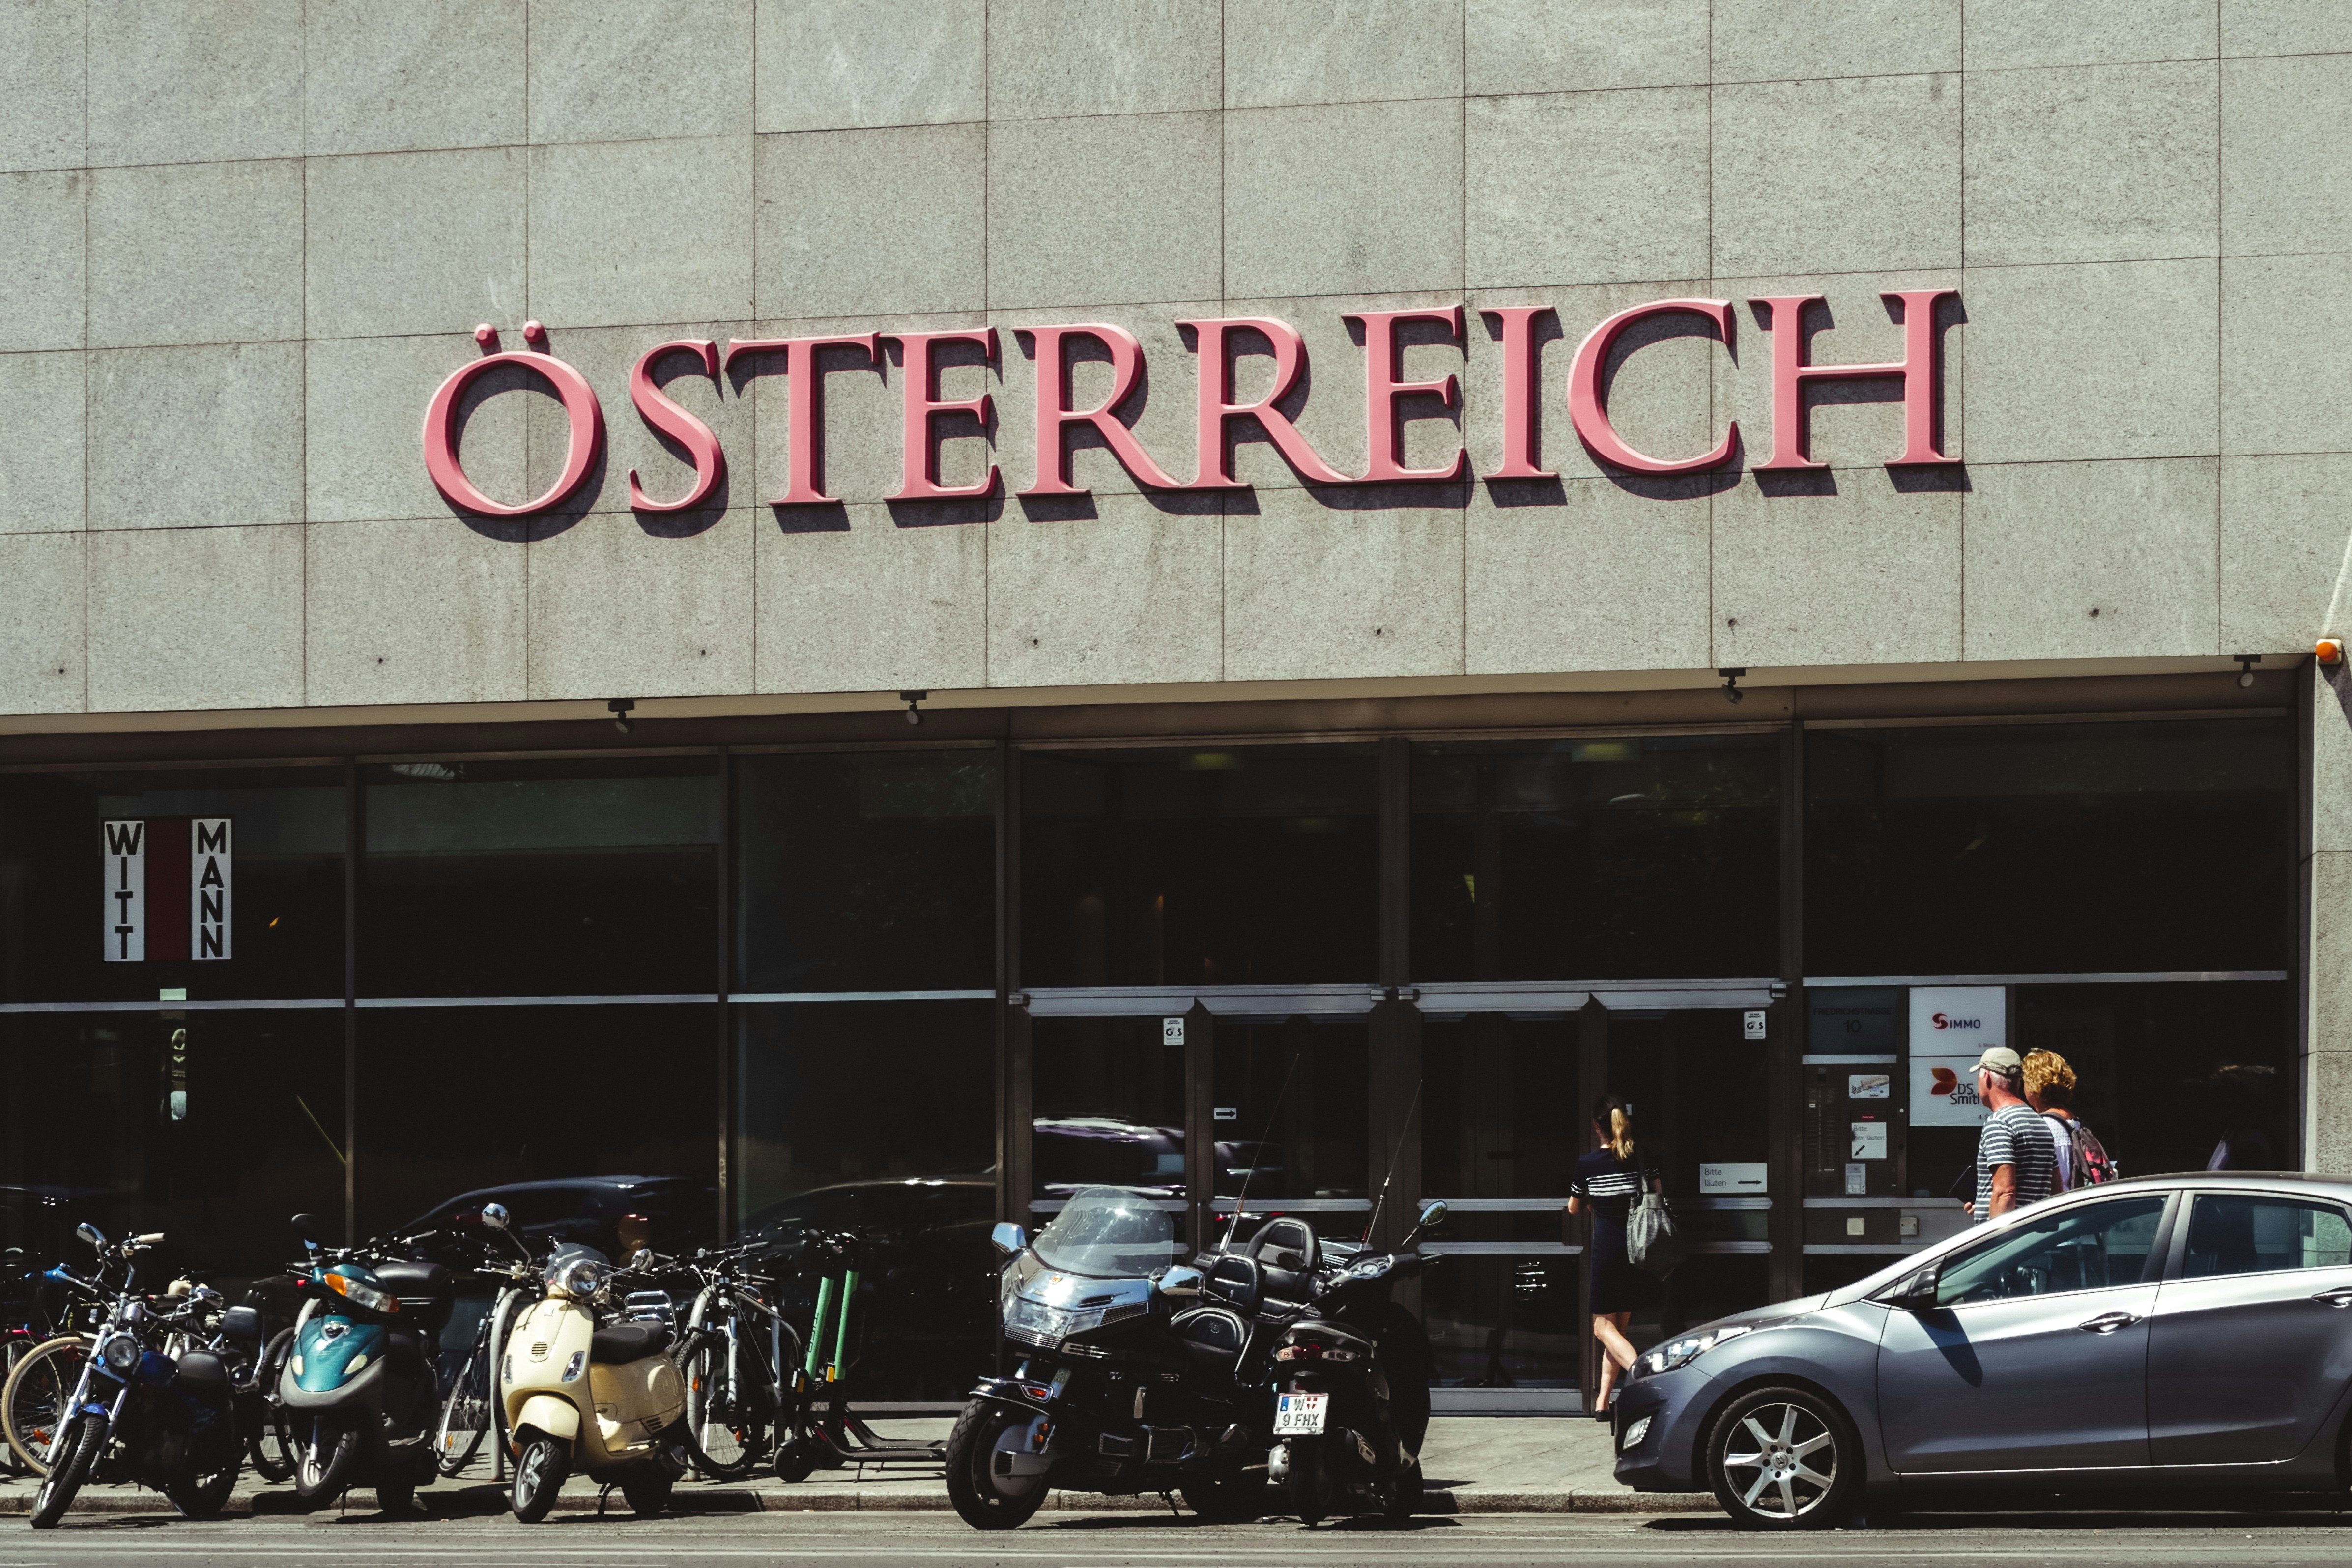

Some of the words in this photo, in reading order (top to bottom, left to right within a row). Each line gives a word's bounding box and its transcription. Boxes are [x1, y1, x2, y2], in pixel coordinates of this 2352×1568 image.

[424, 288, 1964, 516] ÖSTERREICH
[106, 823, 143, 960] WITT
[198, 821, 226, 958] MANN
[1843, 1019, 1862, 1033] 10
[1958, 1083, 1974, 1095] DS
[1704, 1168, 1722, 1176] Bitte
[1294, 1413, 1319, 1426] FHX
